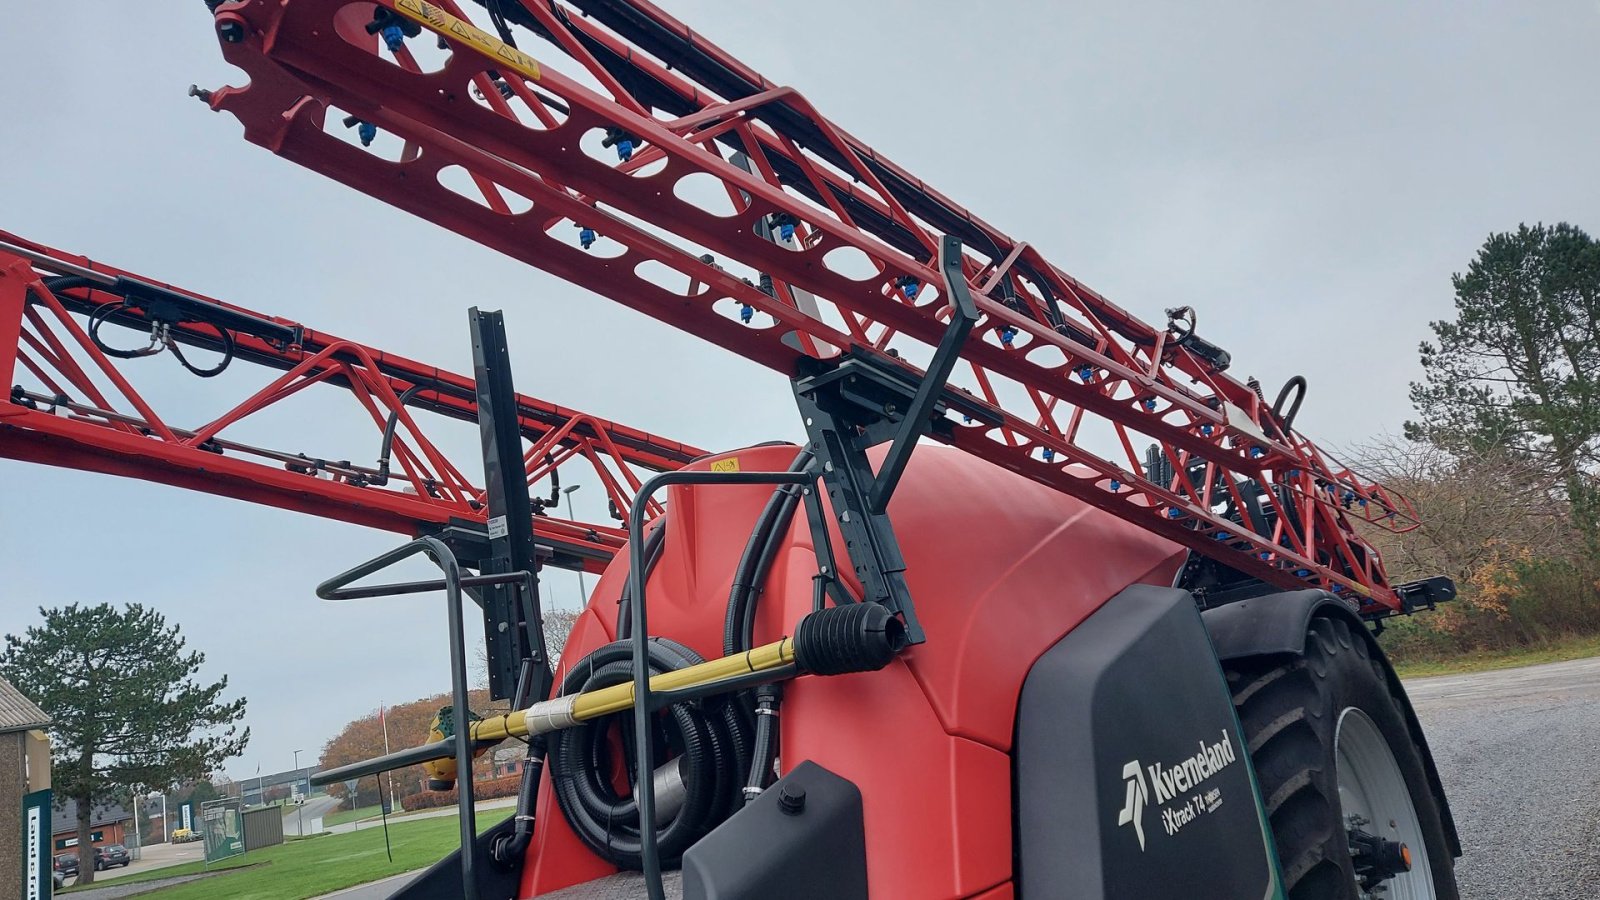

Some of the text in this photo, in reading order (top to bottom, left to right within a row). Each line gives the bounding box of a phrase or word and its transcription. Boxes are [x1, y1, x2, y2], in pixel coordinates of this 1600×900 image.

[1147, 728, 1236, 805] Kverneland
[1161, 801, 1197, 836] iXtrack
[1192, 794, 1206, 815] T4
